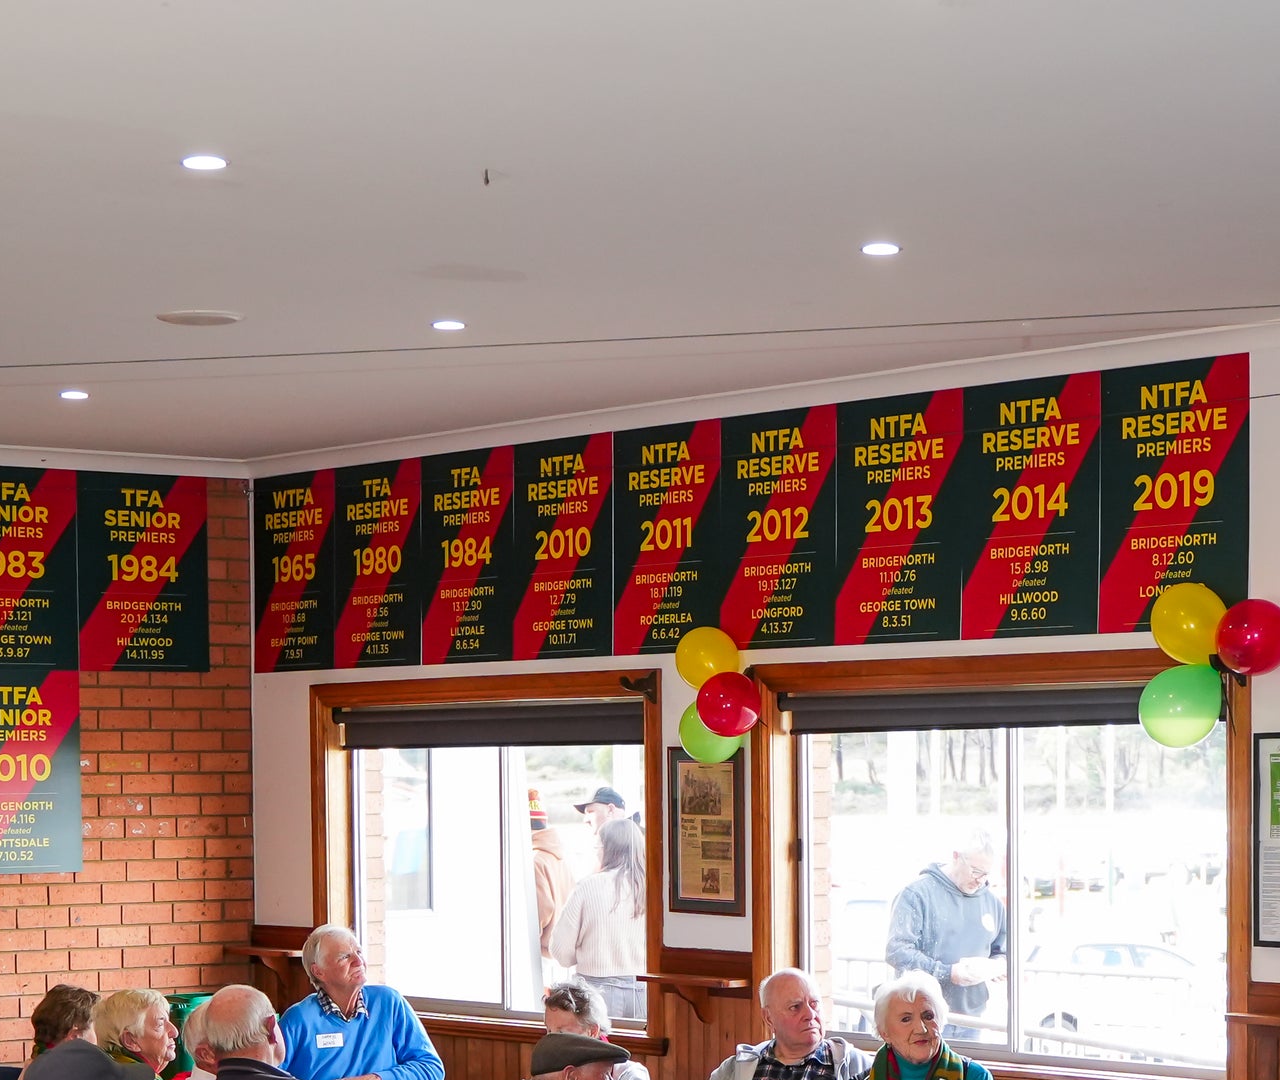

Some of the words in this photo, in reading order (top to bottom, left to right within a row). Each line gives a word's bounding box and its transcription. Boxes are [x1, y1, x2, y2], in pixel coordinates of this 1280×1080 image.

[1140, 379, 1208, 411] NTFA
[999, 396, 1062, 426] NTFA
[869, 412, 927, 441] NTFA
[751, 426, 804, 454] NTFA
[982, 423, 1079, 453] RESERVE
[641, 441, 691, 466] NTFA
[854, 438, 944, 467] RESERVE
[995, 451, 1065, 471] PREMIERS
[450, 465, 481, 487] TFA
[539, 452, 585, 478] NTFA
[866, 465, 931, 484] PREMIERS
[362, 477, 391, 498] TFA
[628, 464, 705, 491] RESERVE
[120, 487, 164, 509] TFA
[273, 487, 314, 509] WTFA
[638, 489, 693, 506] PREMIERS
[1133, 469, 1215, 512] 2019
[991, 481, 1069, 523] 2014
[746, 506, 810, 543] 2012
[864, 495, 933, 533] 2013
[534, 526, 591, 560] 2010
[639, 516, 692, 552] 2011
[353, 544, 402, 576] 1980
[441, 535, 493, 568] 1984
[862, 552, 936, 568] BRIDGENORTH
[991, 542, 1070, 560] BRIDGENORTH
[106, 553, 179, 583] 1984
[271, 553, 316, 583] 1965
[635, 569, 698, 585] BRIDGENORTH
[879, 568, 919, 584] 11.10.76
[1011, 559, 1050, 575] 15.8.98
[650, 584, 684, 599] 18.11.119
[999, 590, 1059, 605] HILLWOOD
[861, 599, 901, 612] GEORGE
[904, 598, 936, 611] TOWN
[1010, 606, 1047, 622] 9.6.60
[640, 613, 692, 625] ROCHERLEA
[881, 614, 913, 629] 8.3.51
[19, 634, 52, 645] TOWN
[652, 627, 681, 640] 6.6.42
